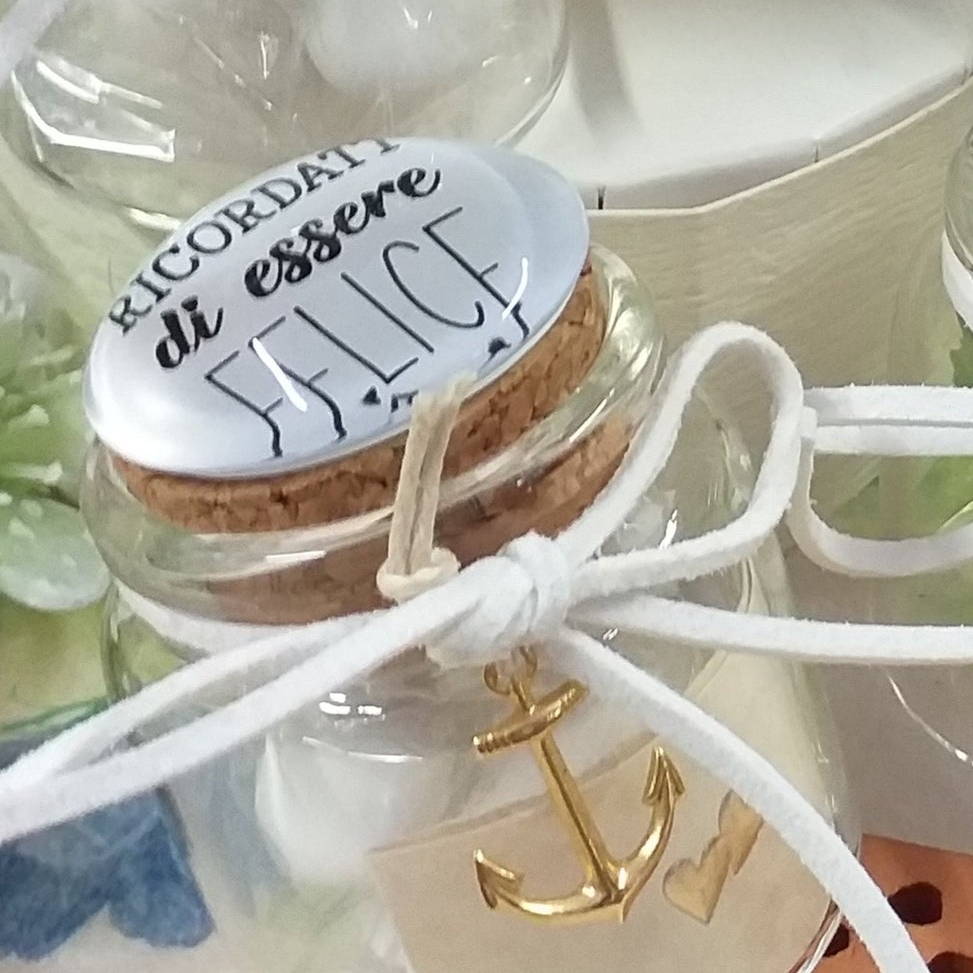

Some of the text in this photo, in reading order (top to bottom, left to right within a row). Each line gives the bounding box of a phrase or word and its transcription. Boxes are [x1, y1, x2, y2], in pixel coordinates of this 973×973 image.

[154, 163, 442, 370] di essere
[204, 206, 531, 458] FELICE
